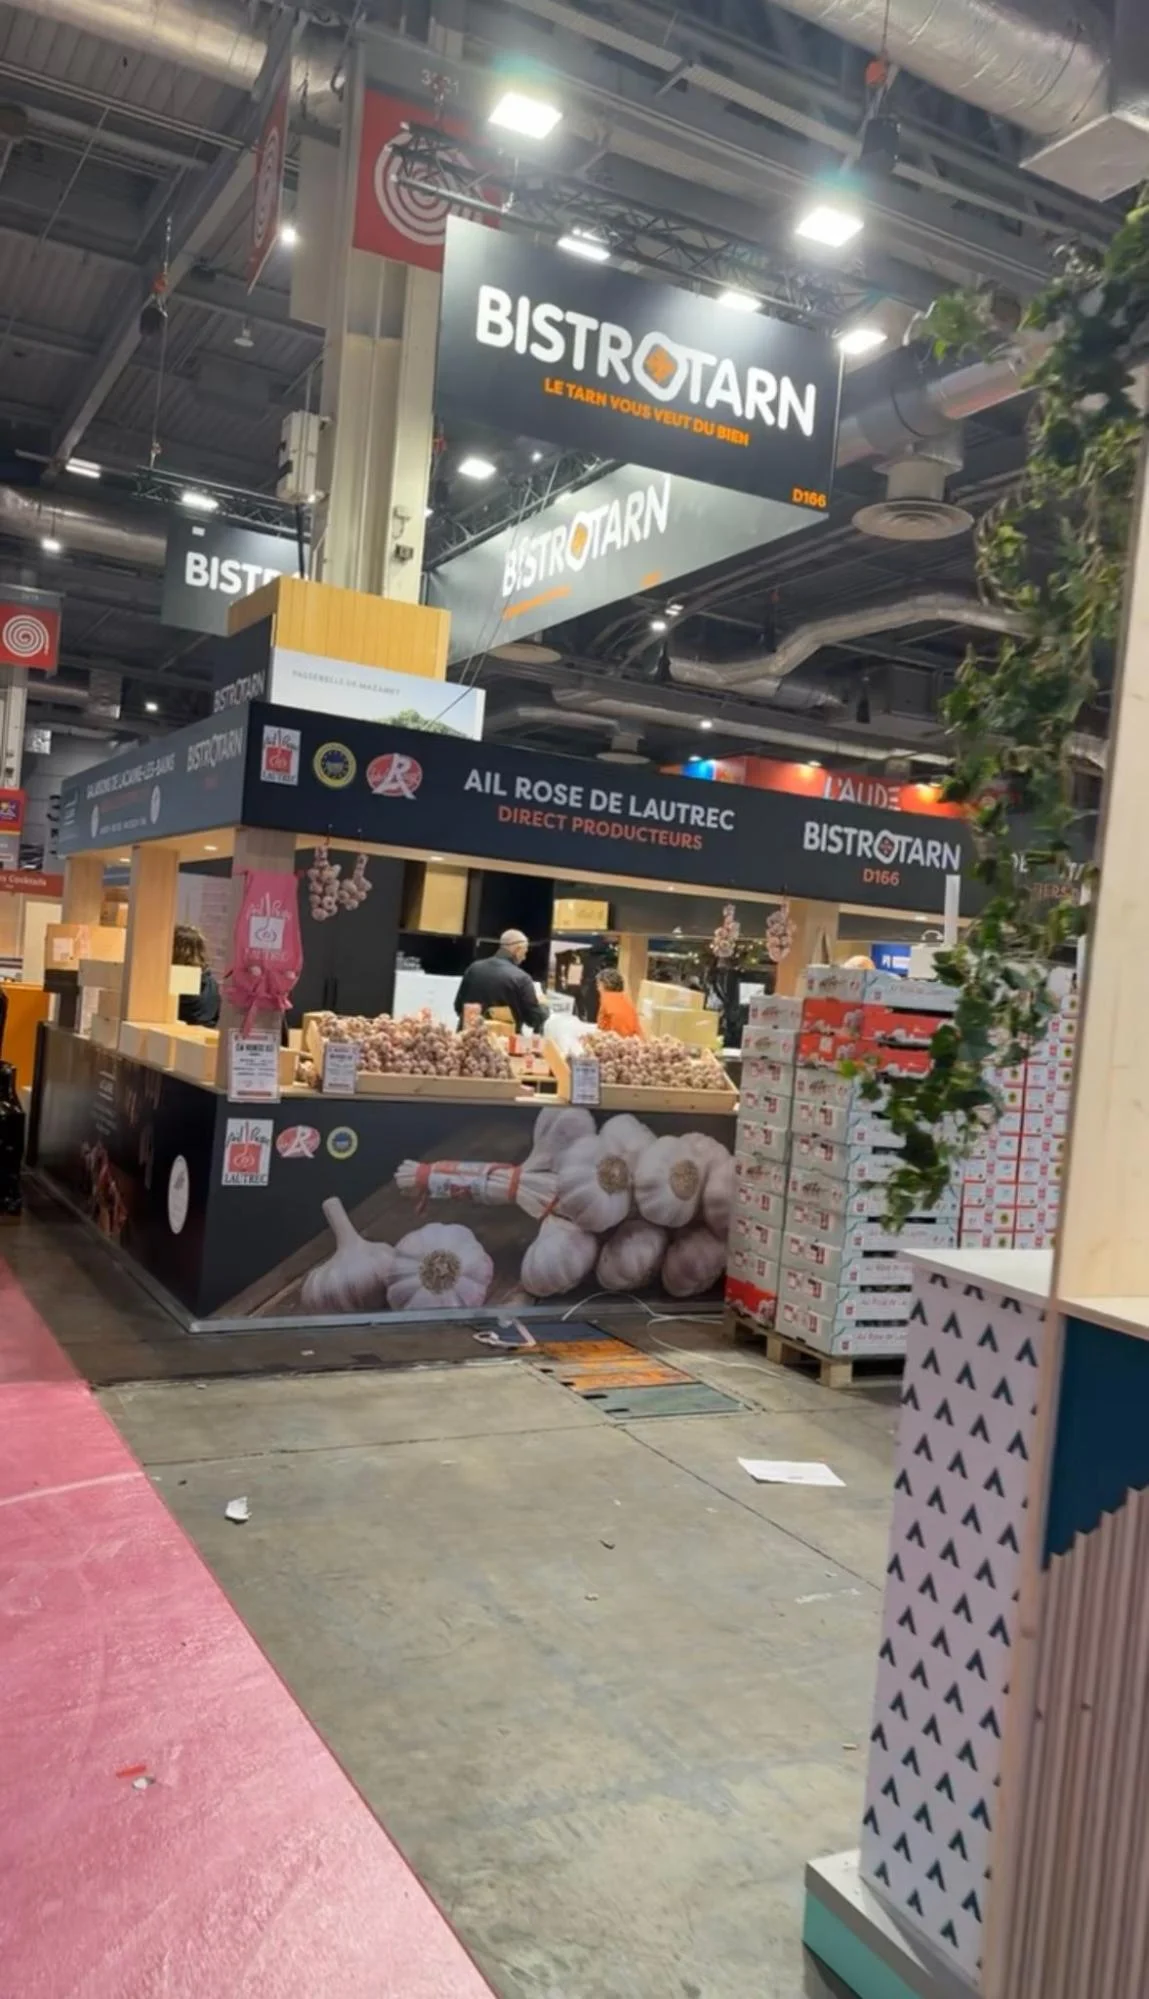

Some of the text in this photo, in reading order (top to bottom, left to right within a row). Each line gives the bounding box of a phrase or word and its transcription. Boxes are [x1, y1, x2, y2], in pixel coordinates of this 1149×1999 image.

[475, 284, 817, 437] BISTROTARN
[544, 377, 750, 447] LE TARN VOUS VEUT DU BIEN
[792, 488, 827, 508] D166
[502, 474, 671, 597] BISTROTARN
[464, 769, 735, 831] AIL ROSE DE LAUTREC
[497, 805, 702, 850] DIRECT PRODUCTEURS
[803, 820, 960, 871] BISTROTARN
[863, 868, 900, 887] D166
